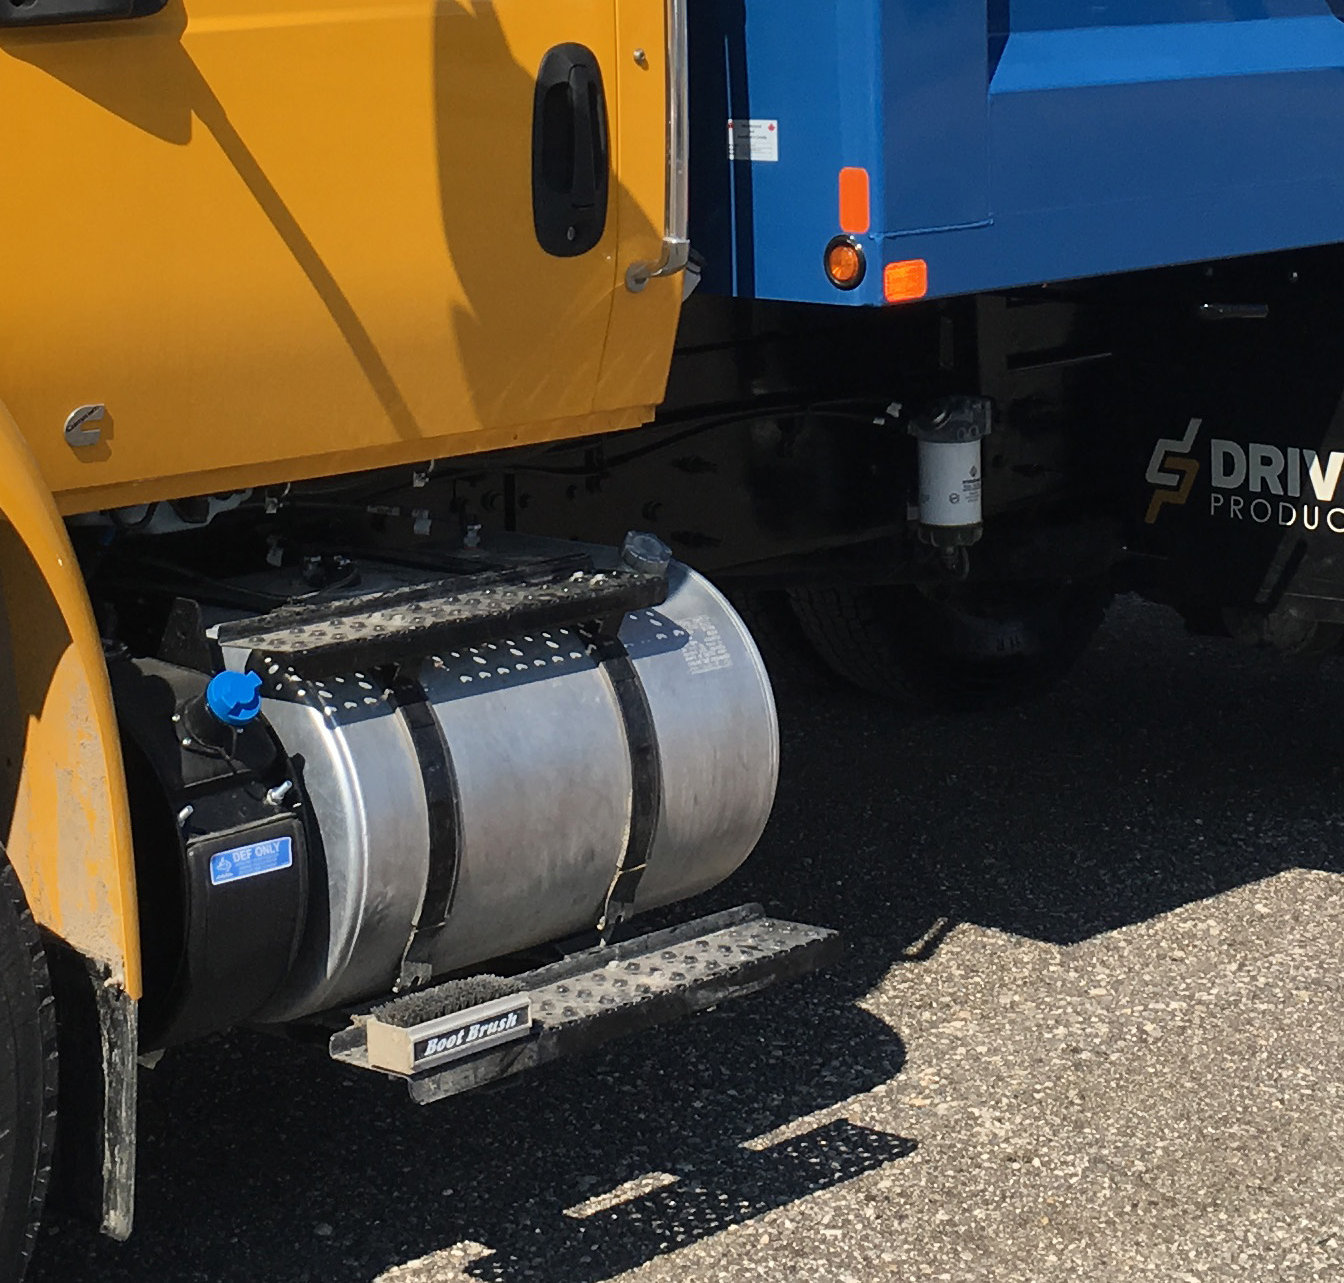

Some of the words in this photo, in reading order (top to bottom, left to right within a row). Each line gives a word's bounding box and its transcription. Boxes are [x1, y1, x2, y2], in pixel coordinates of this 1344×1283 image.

[232, 848, 253, 863] DEF
[254, 841, 281, 858] ONLY
[423, 1028, 465, 1057] Boot
[466, 1011, 519, 1042] Brush
